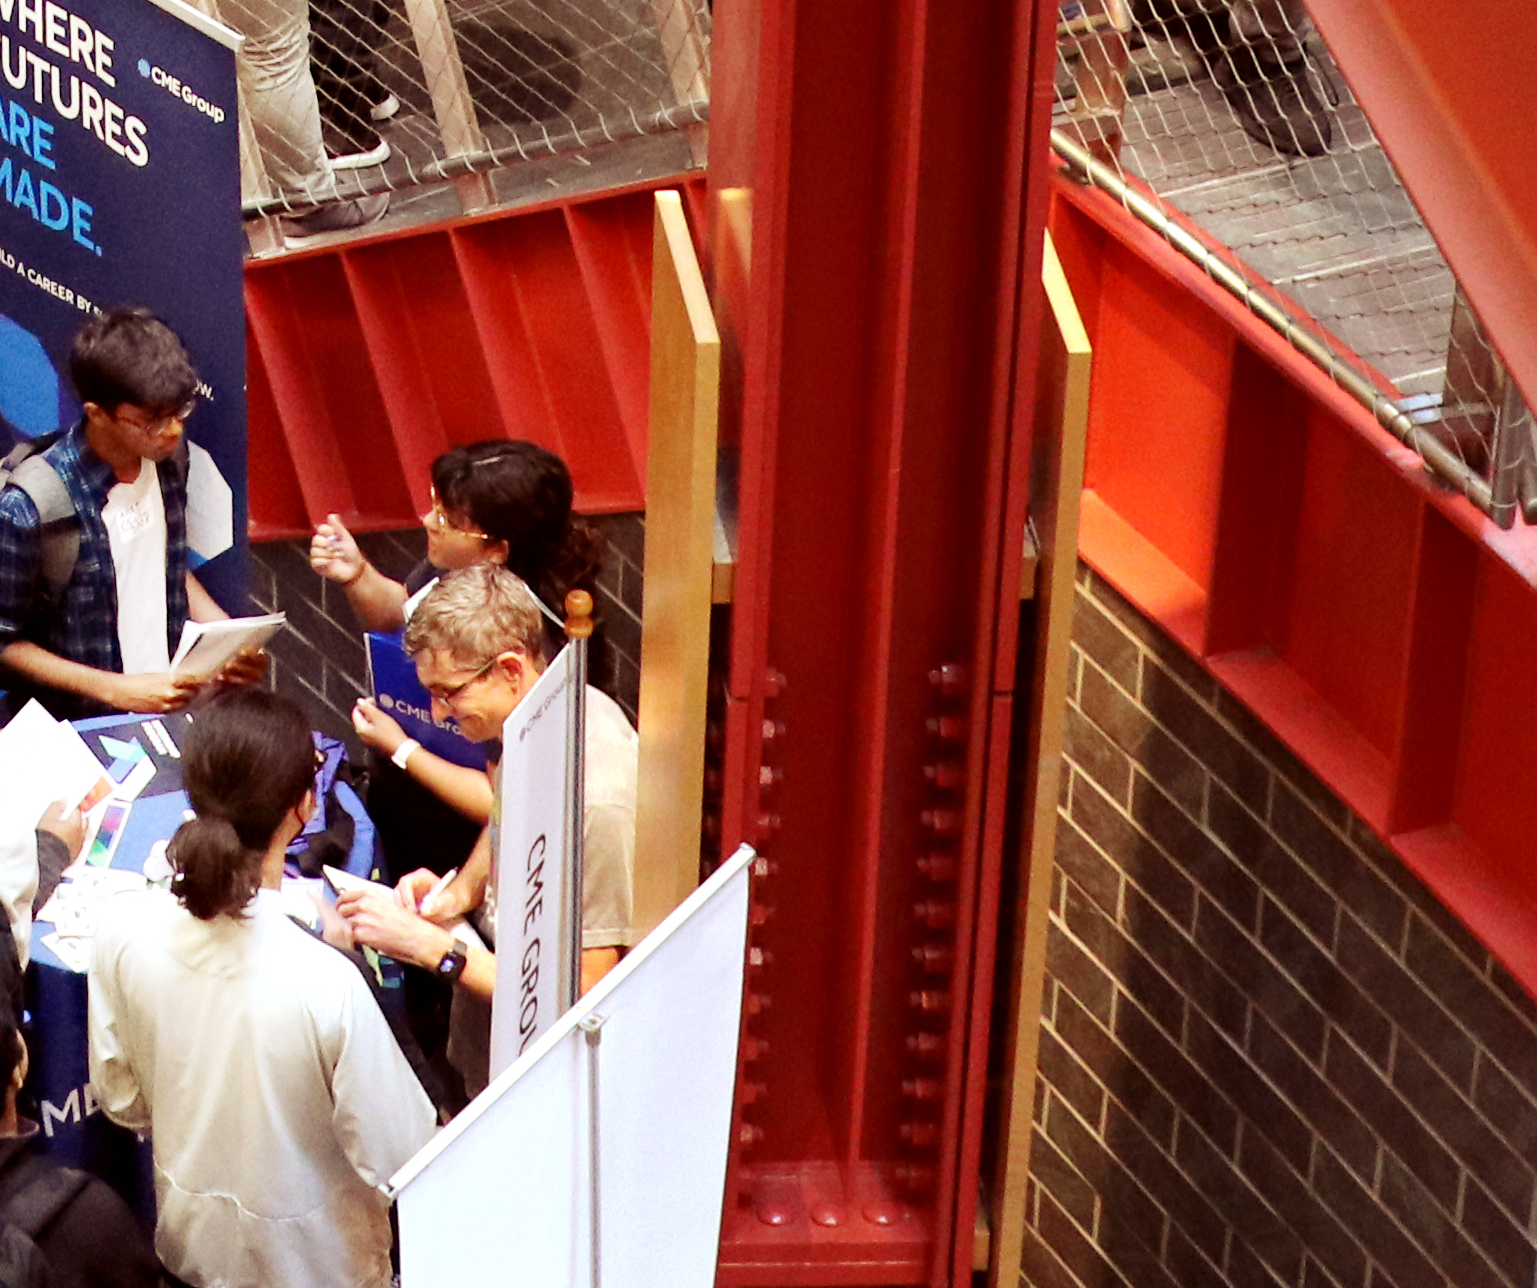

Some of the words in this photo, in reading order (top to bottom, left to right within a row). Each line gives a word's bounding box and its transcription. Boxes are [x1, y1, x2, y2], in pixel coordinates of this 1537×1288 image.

[151, 66, 181, 98] CME
[181, 85, 225, 124] Group
[16, 262, 26, 277] A
[26, 268, 74, 306] CAREER
[76, 294, 93, 314] BY
[395, 699, 432, 724] CME
[522, 833, 547, 937] CME
